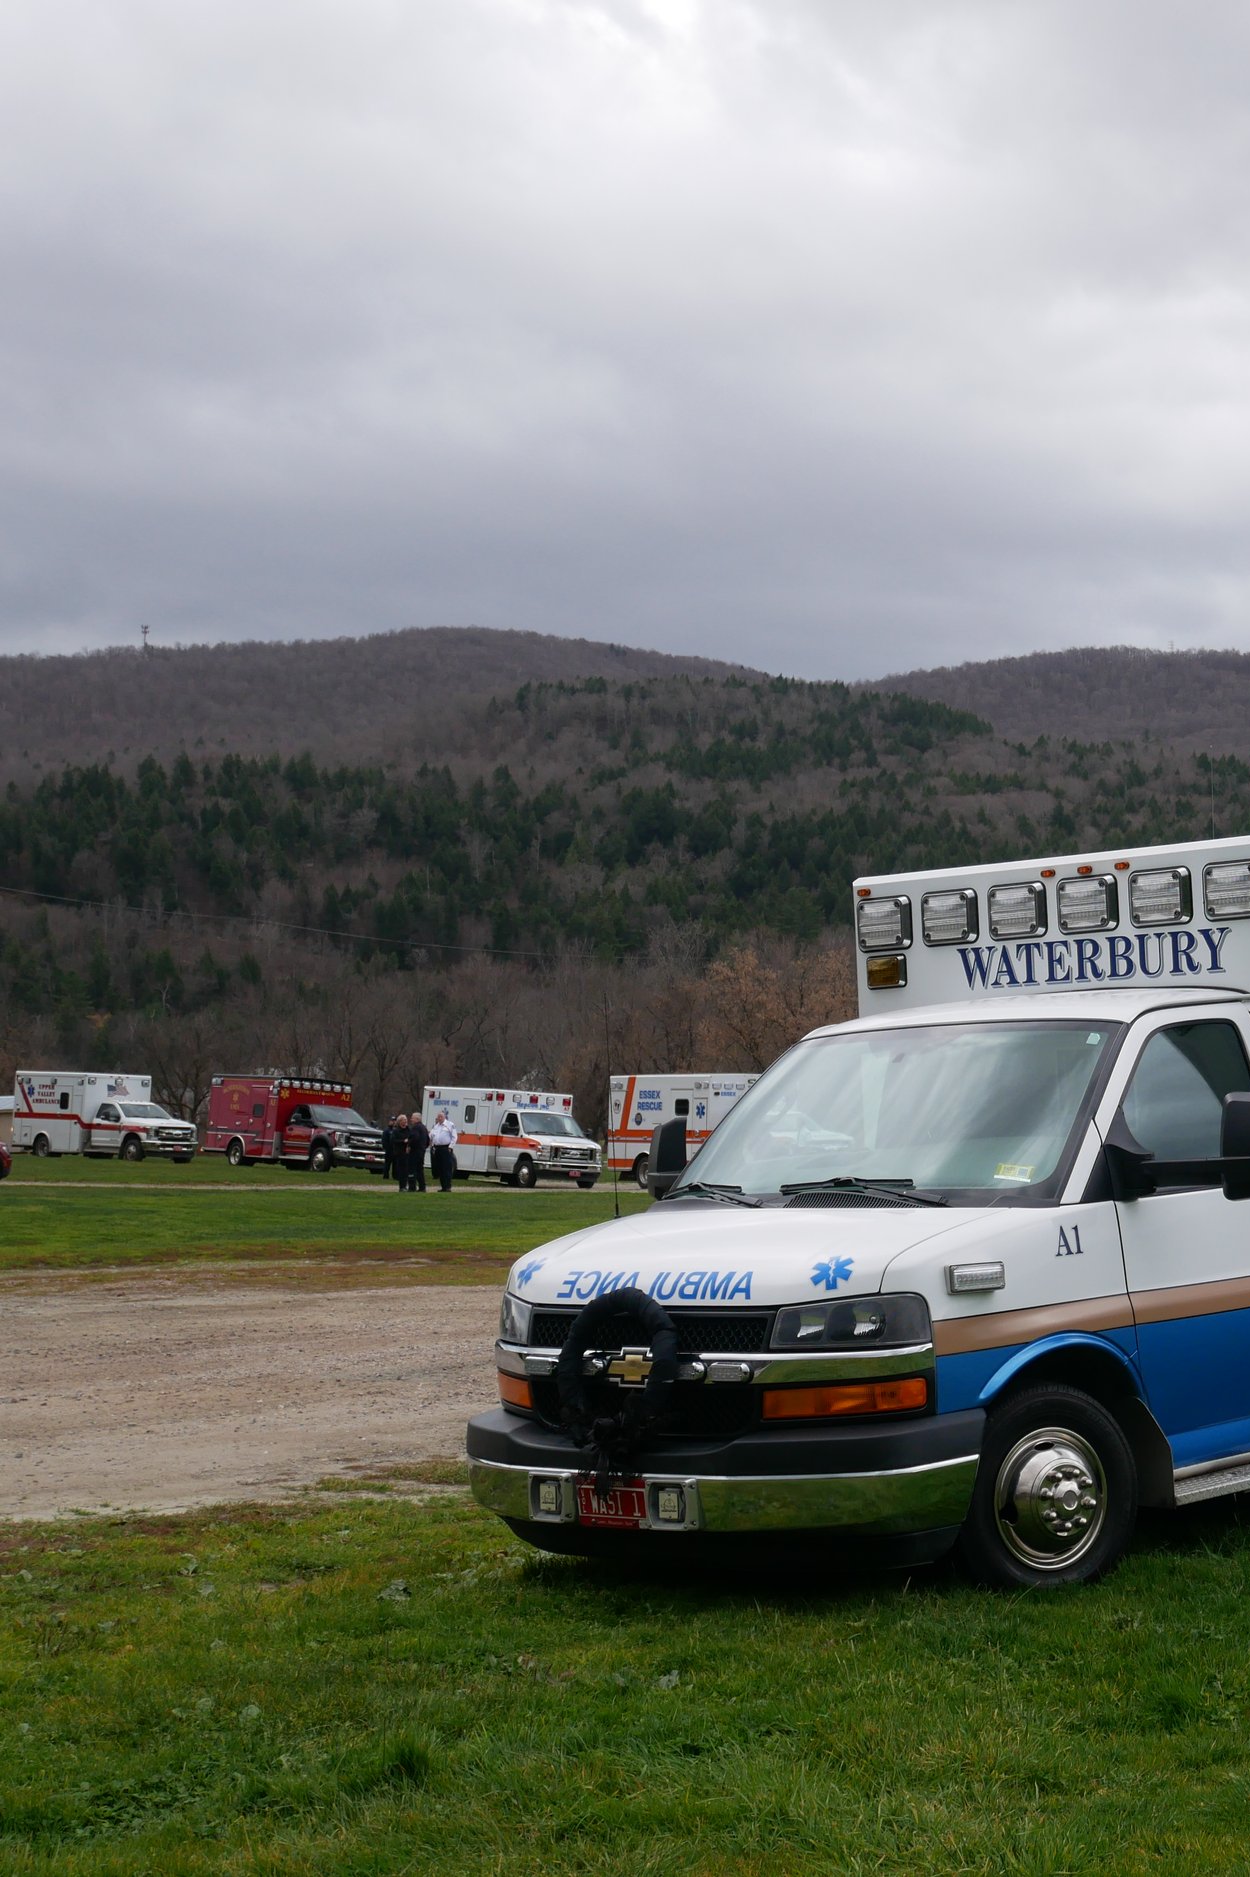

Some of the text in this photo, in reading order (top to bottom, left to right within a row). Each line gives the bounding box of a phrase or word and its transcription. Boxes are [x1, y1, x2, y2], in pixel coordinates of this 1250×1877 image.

[957, 927, 1232, 990] WATERBURY
[639, 1090, 660, 1099] ESSEX
[637, 1101, 663, 1111] RESCUE
[1055, 1225, 1084, 1257] A1
